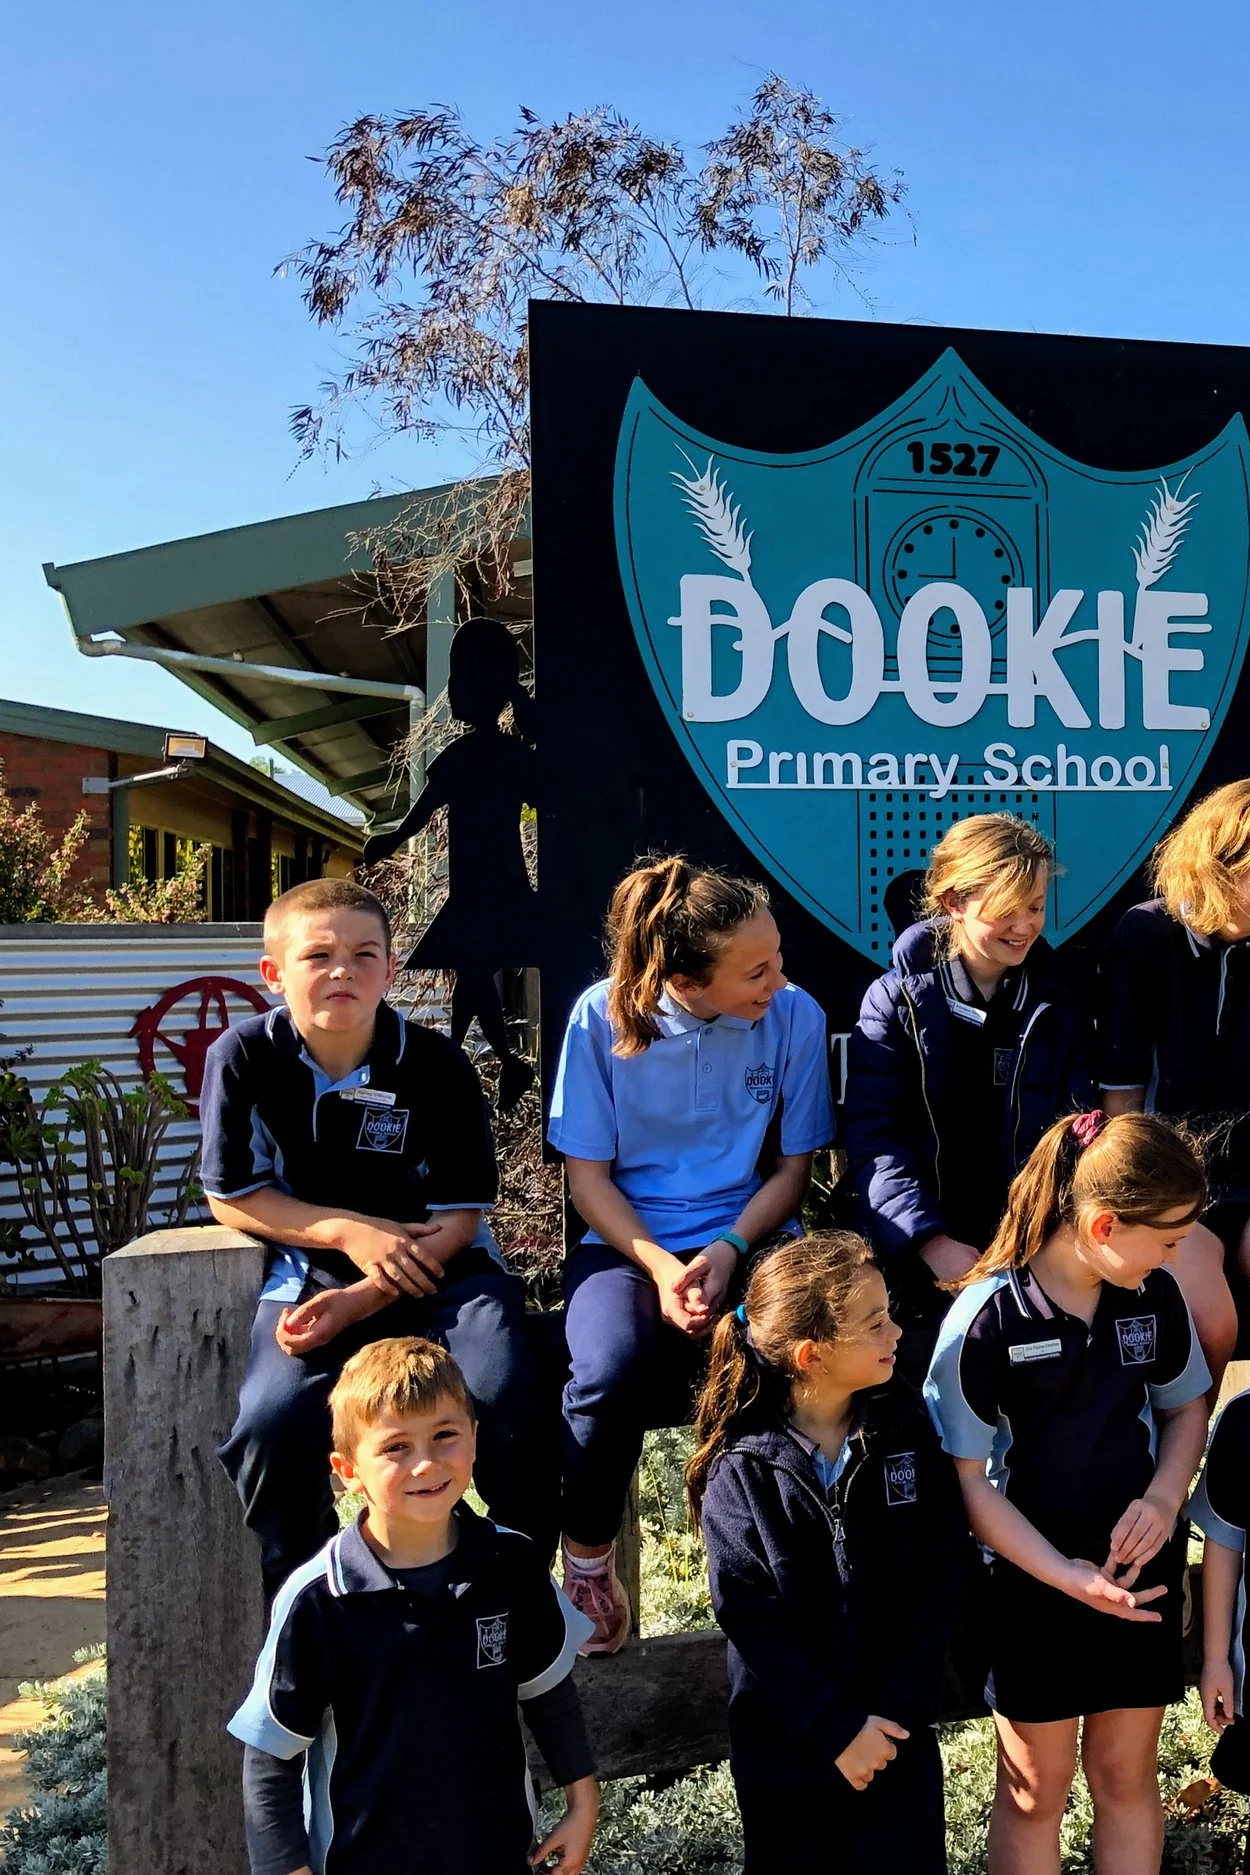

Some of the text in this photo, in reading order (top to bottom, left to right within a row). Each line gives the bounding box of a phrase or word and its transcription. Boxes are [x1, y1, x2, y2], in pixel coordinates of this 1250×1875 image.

[907, 441, 1000, 477] 1527
[679, 573, 1212, 731] DOOKIE
[727, 740, 1170, 798] Primary School
[747, 1075, 773, 1086] DOOK
[366, 1121, 402, 1134] DOOKIE
[1122, 1330, 1153, 1344] DOOKIE
